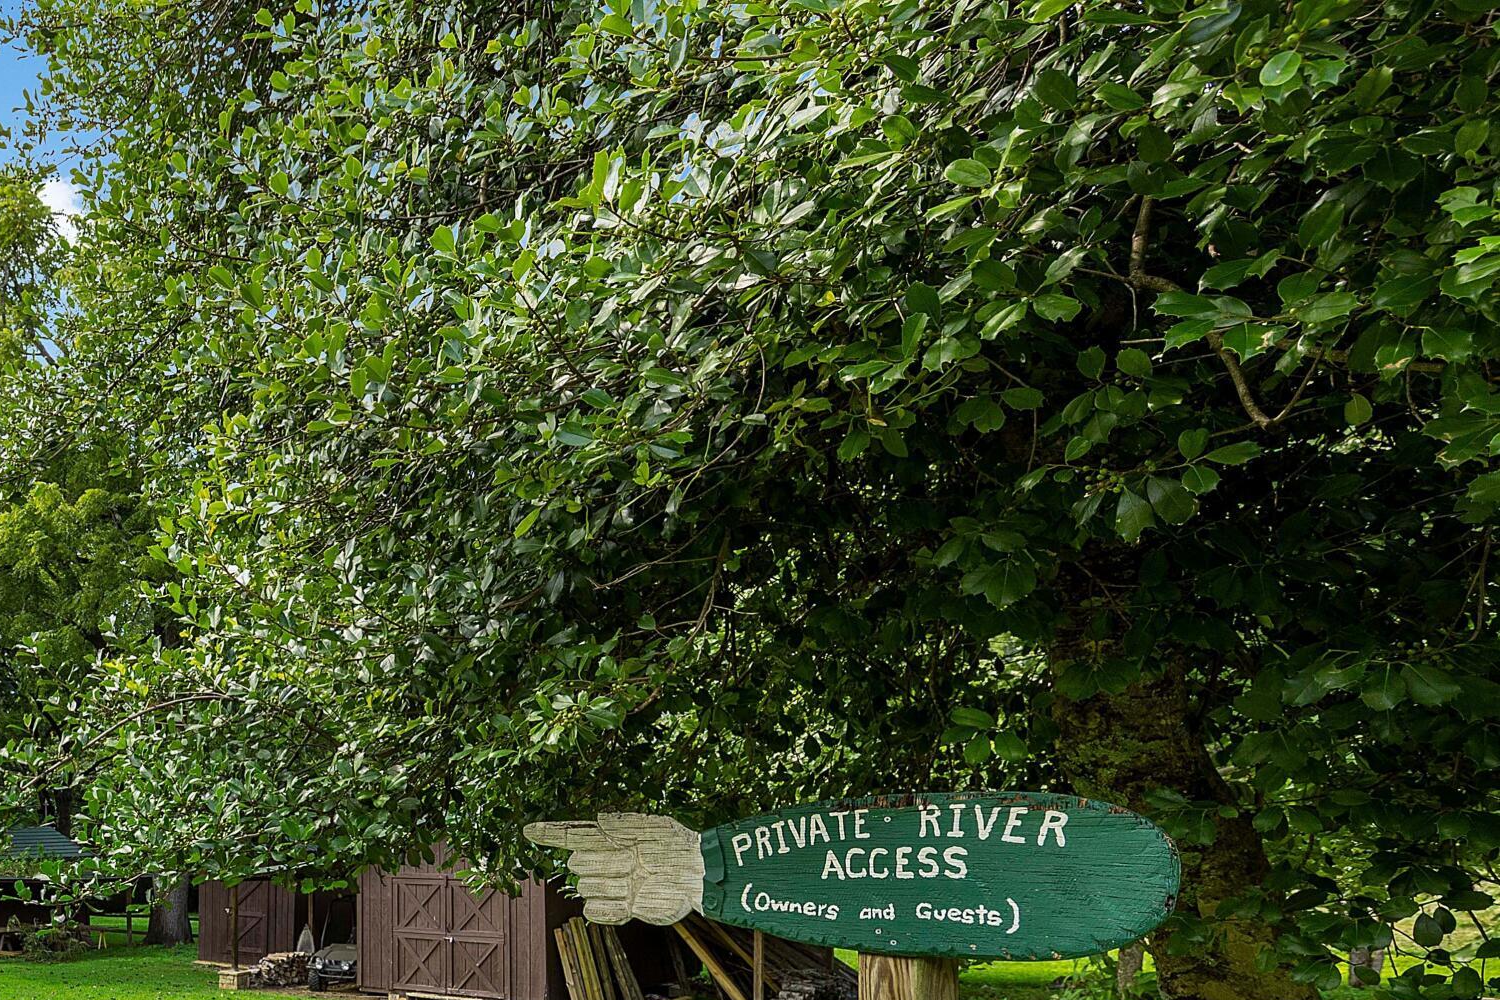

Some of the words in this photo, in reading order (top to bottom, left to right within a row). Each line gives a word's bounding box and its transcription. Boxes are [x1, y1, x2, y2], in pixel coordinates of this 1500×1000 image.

[732, 808, 871, 867] PRIVATE
[918, 803, 1069, 847] RIVER
[821, 846, 968, 881] ACCESS
[740, 883, 839, 921] (Owners
[859, 903, 895, 921] and
[915, 898, 1021, 933] Guests)
